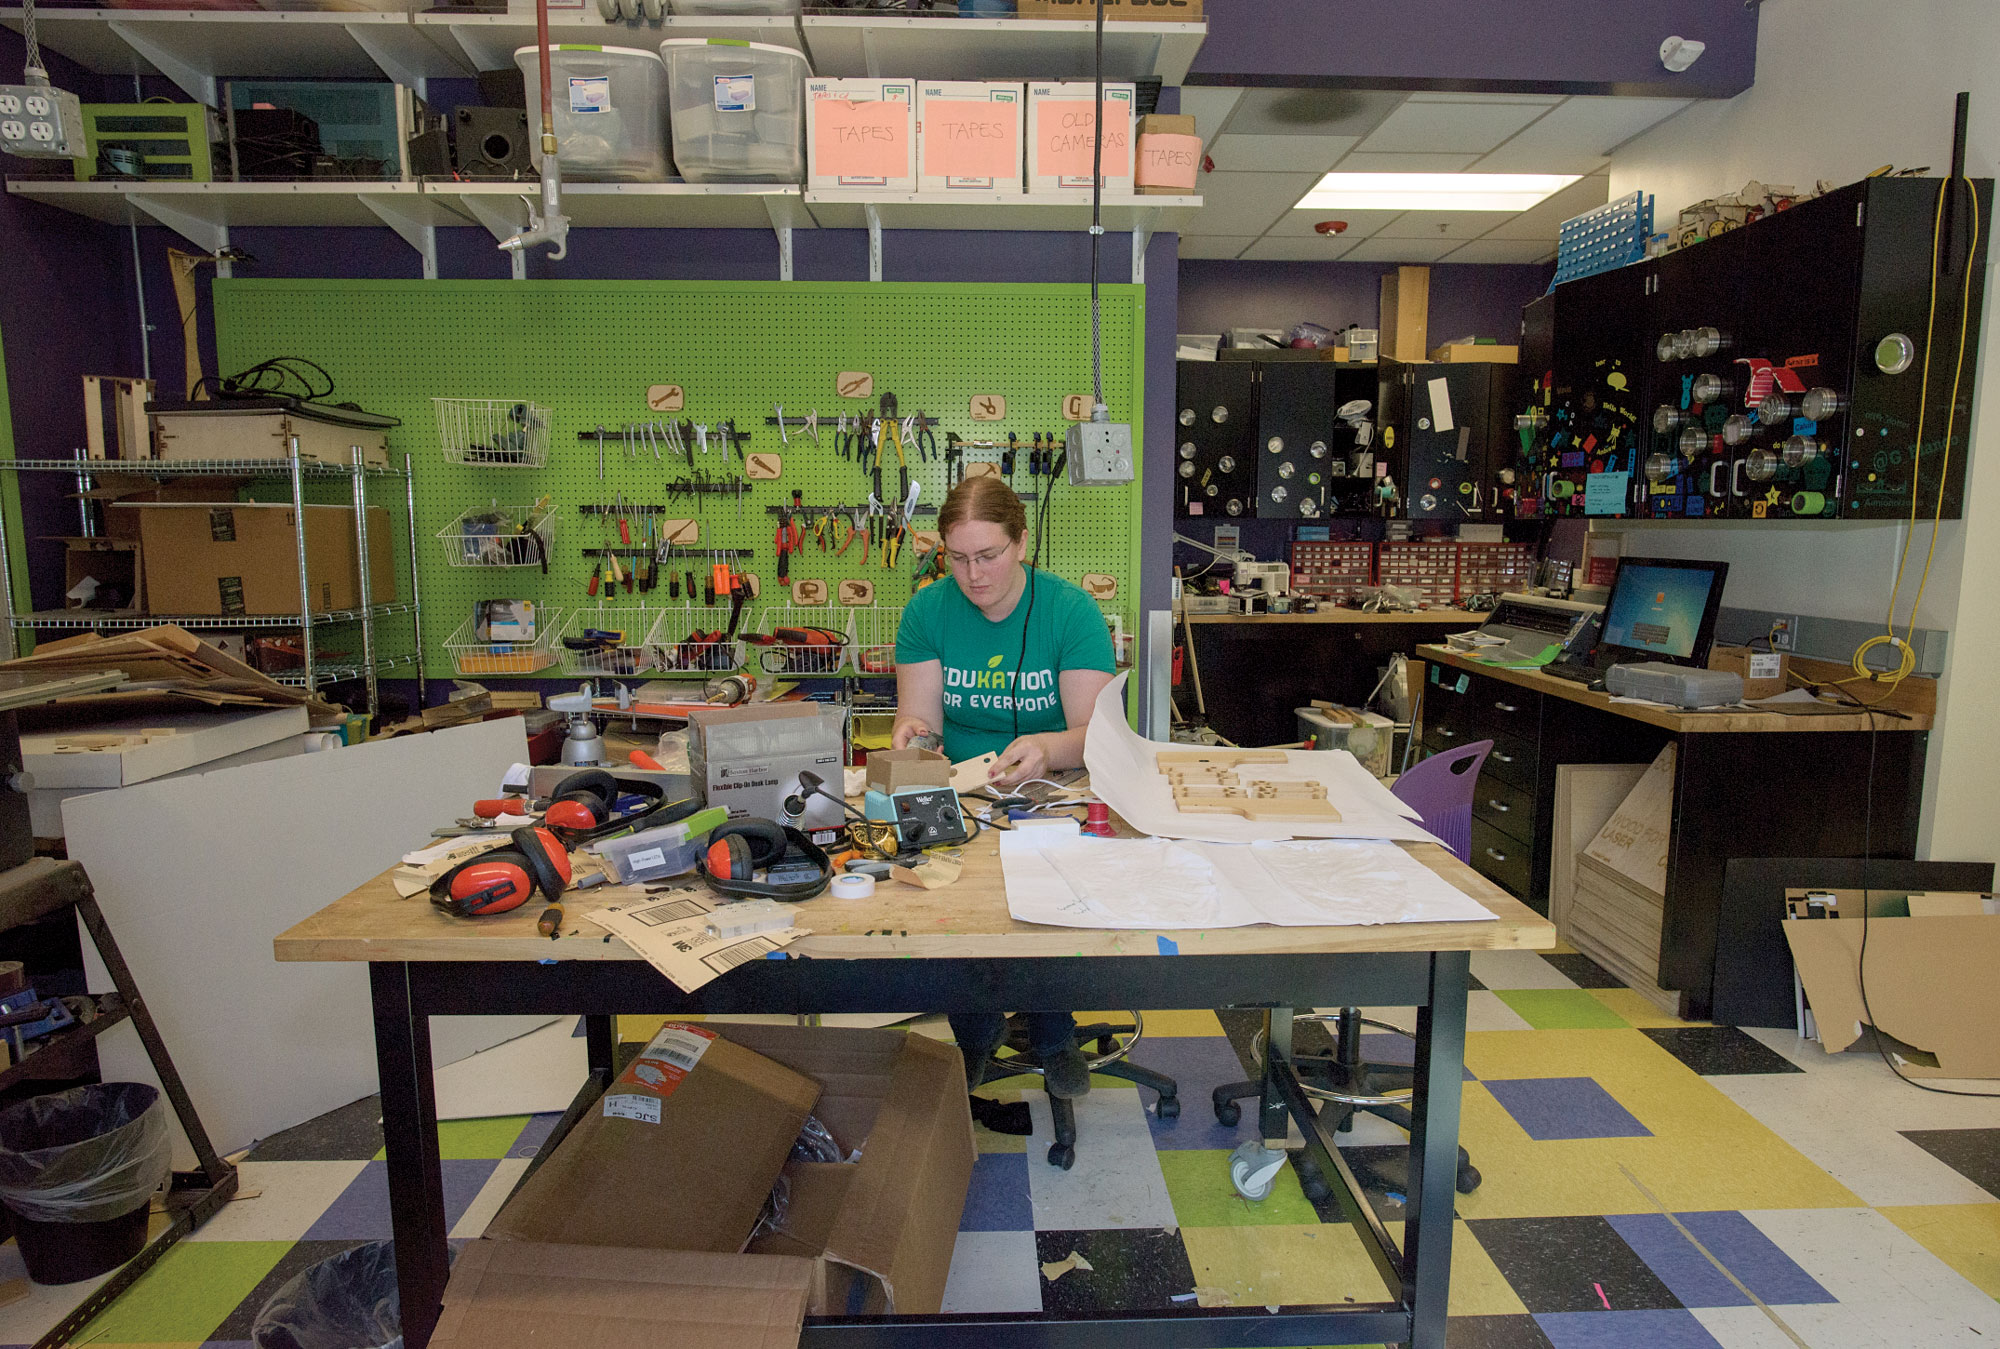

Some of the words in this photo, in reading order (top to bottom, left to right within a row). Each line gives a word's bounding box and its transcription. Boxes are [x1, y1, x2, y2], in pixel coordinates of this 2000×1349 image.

[810, 84, 827, 92] NAME
[925, 88, 942, 96] NAME
[1033, 88, 1051, 96] NAME
[1061, 112, 1095, 129] OLD
[832, 125, 894, 144] TAPES
[942, 122, 1004, 140] TAPES
[1050, 132, 1126, 153] CAMERAS
[1144, 149, 1193, 167] TAPES
[1795, 422, 1814, 432] Calvin
[943, 691, 962, 708] OR
[970, 691, 1057, 712] EVERYONE
[749, 766, 768, 775] Harbor
[713, 783, 733, 792] Flexible
[733, 781, 751, 790] Clip-On
[751, 780, 763, 788] Desk
[1601, 826, 1634, 851] LASER
[672, 940, 692, 953] 3M
[635, 1112, 658, 1122] SJC
